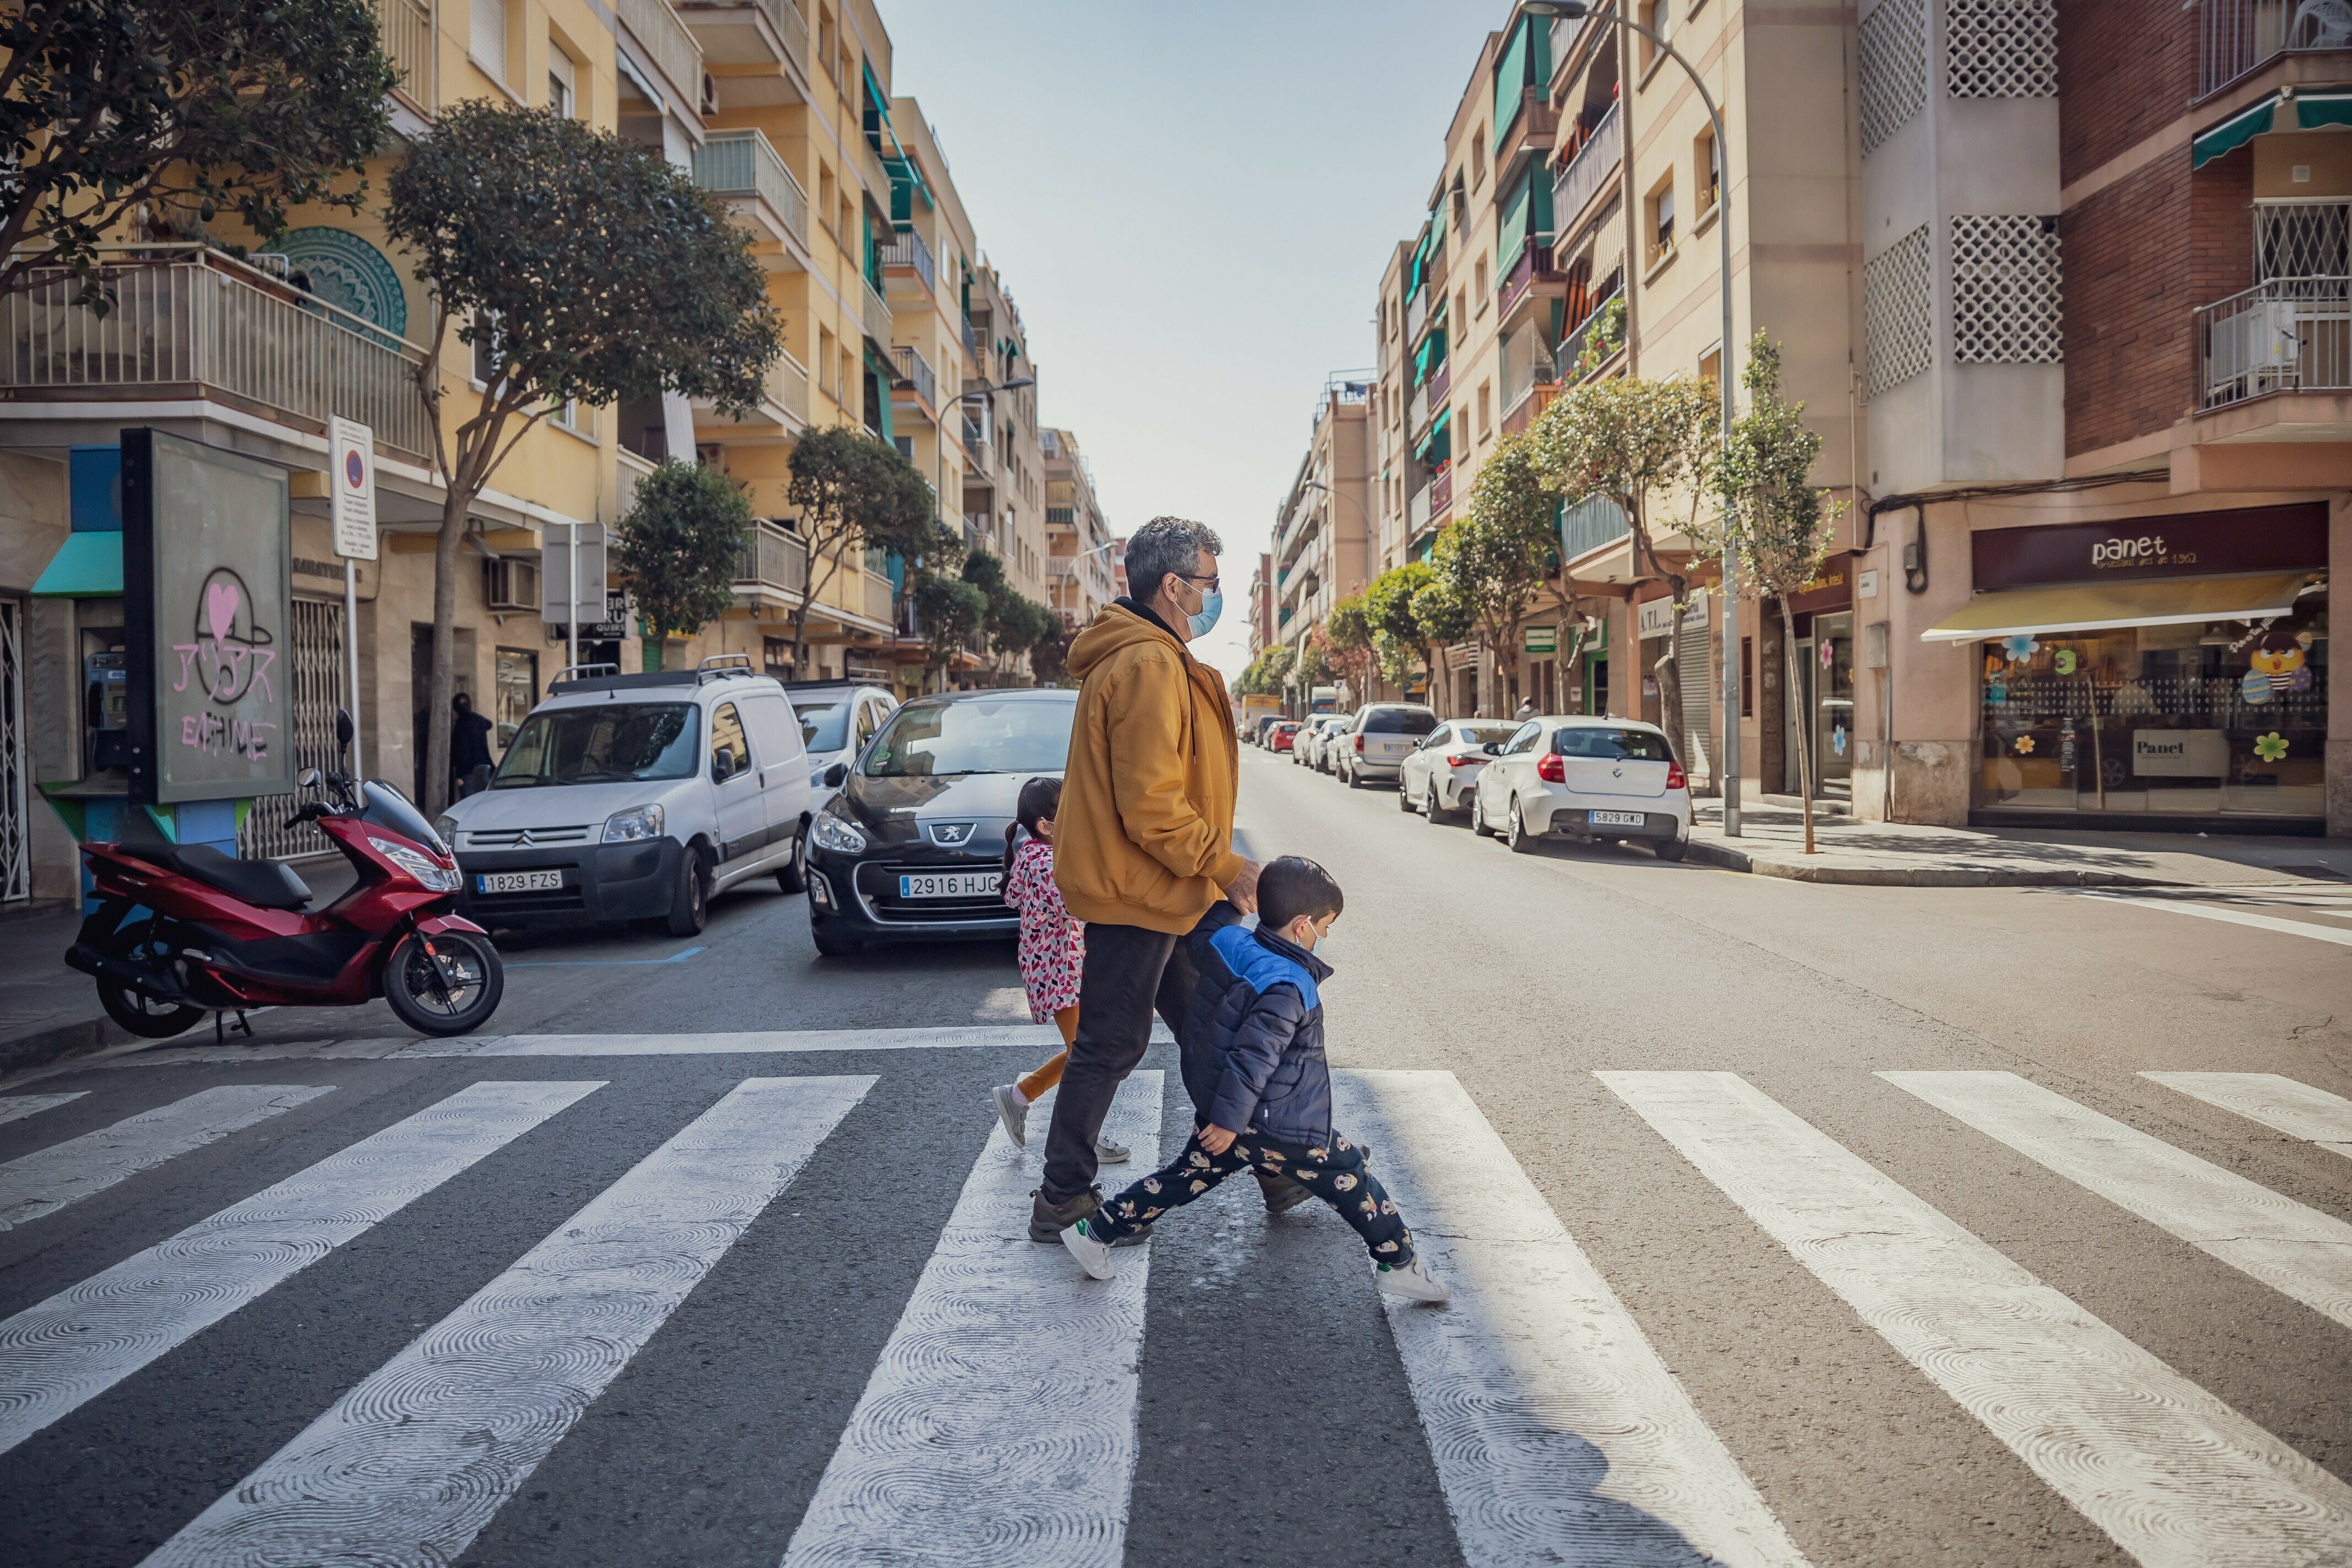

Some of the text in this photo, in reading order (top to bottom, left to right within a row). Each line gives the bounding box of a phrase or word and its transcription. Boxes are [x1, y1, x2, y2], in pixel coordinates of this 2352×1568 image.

[2092, 536, 2167, 564] panet
[1596, 812, 1641, 823] 5829 GWD
[489, 875, 525, 891] 1829
[530, 873, 558, 888] FZS
[913, 878, 958, 894] 2916
